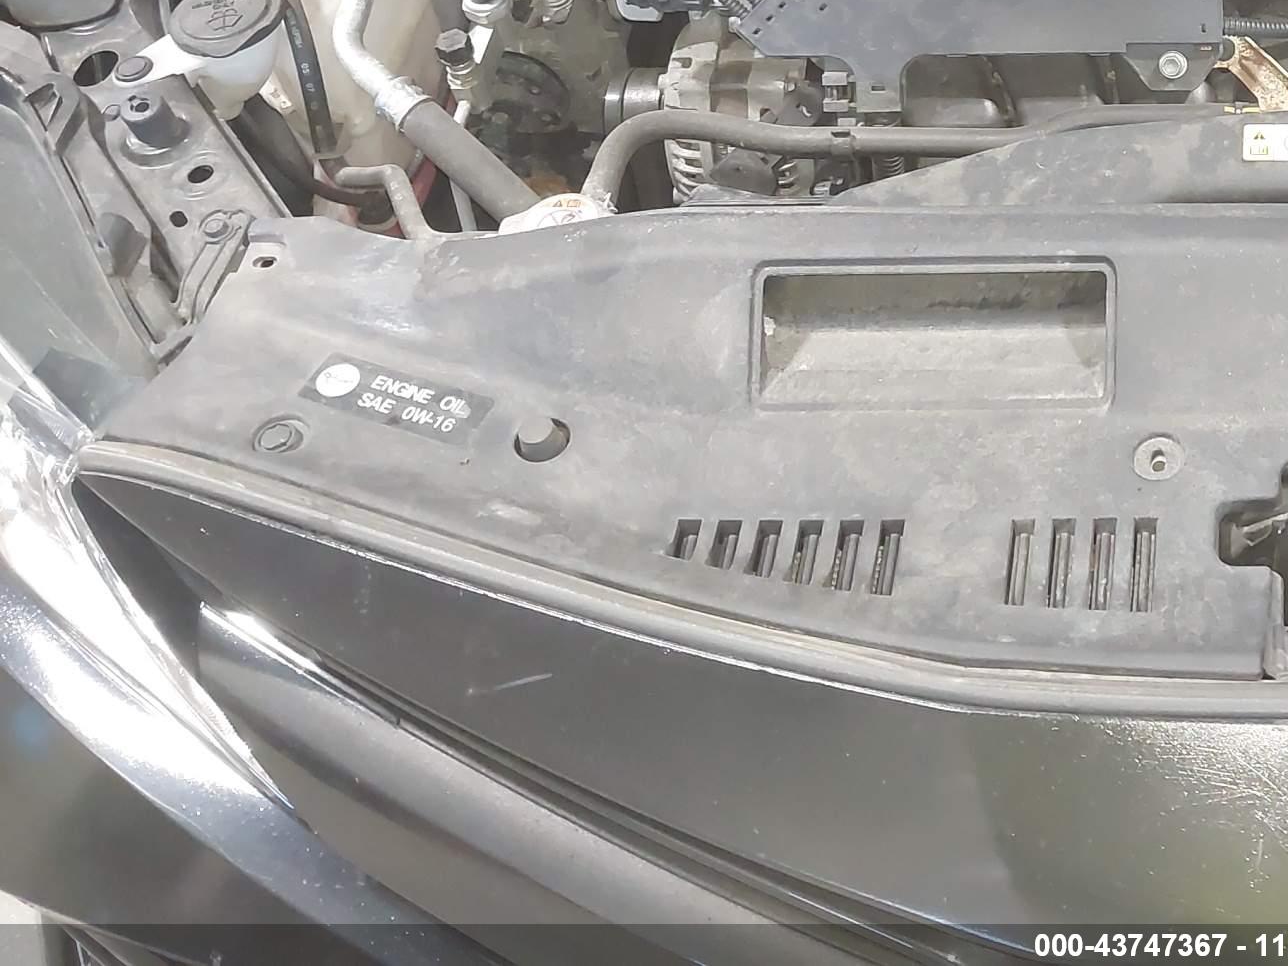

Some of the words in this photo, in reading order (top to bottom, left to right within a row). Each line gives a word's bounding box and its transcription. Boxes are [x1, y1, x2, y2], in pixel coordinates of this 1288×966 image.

[357, 392, 397, 414] SAE
[401, 406, 457, 432] 0W-16
[371, 375, 435, 405] ENGINE
[439, 395, 469, 417] OIL
